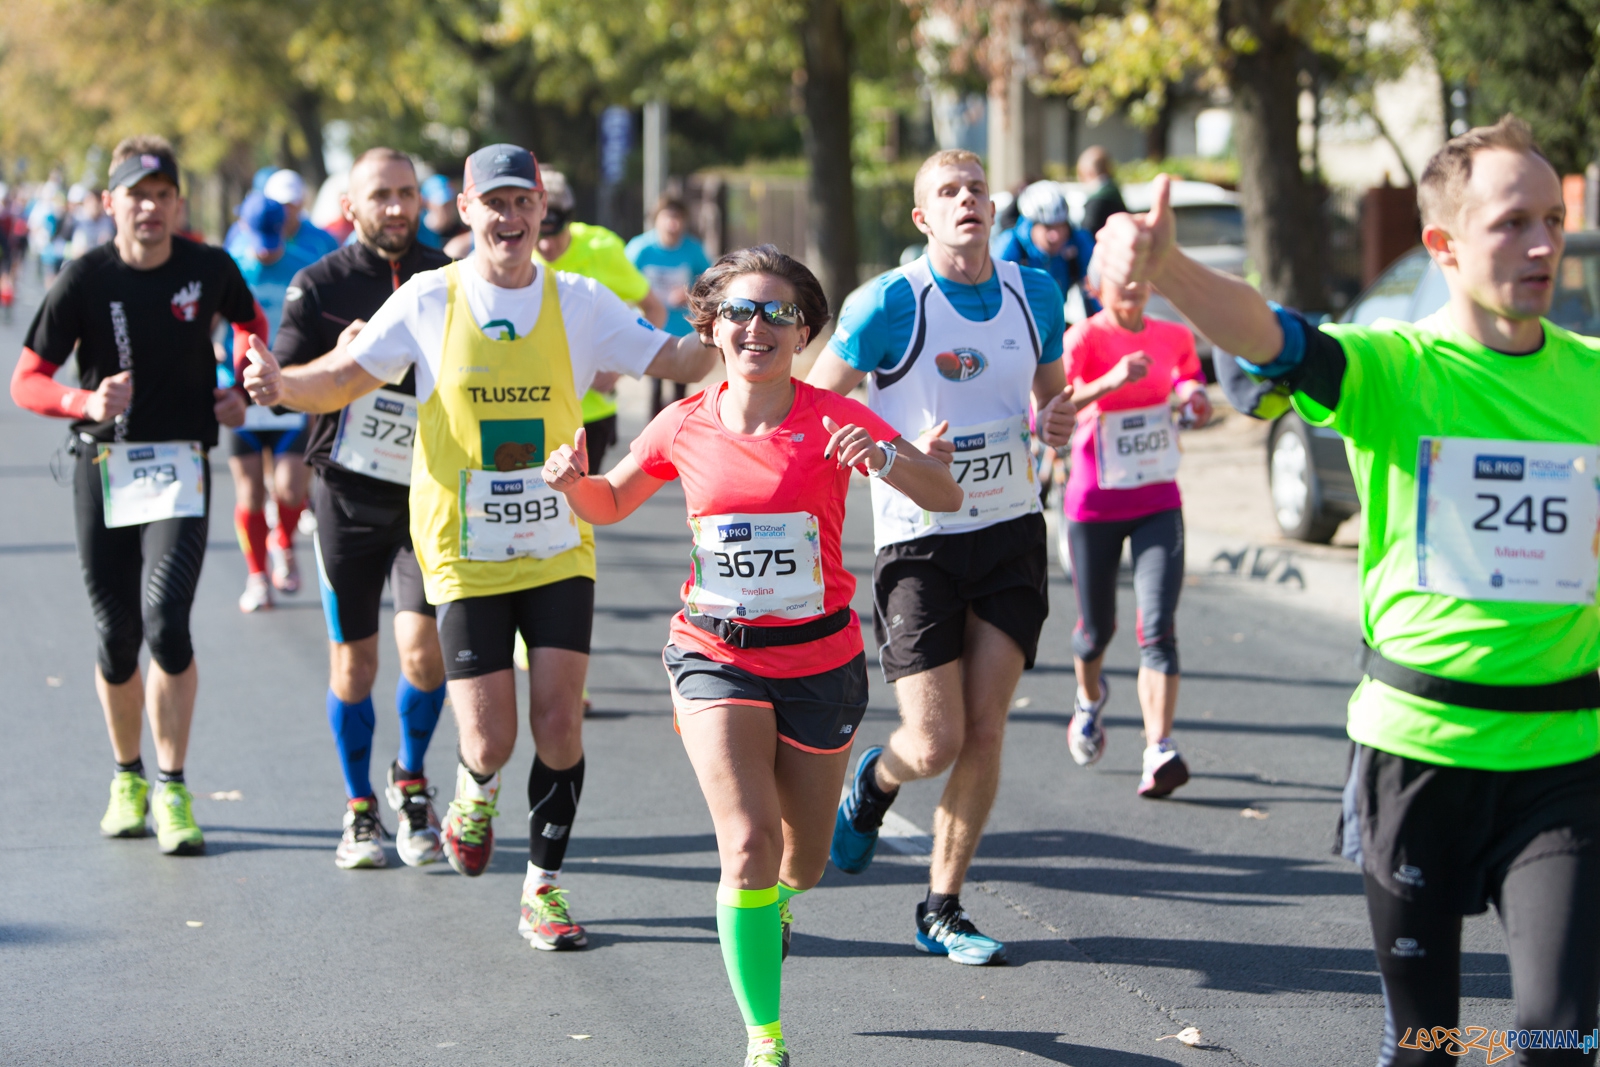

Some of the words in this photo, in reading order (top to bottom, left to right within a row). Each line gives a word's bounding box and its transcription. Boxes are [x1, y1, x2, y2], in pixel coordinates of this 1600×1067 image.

[468, 386, 551, 403] TŁUSZCZ
[361, 414, 416, 448] 372
[953, 452, 1013, 484] 7371
[484, 496, 559, 524] 5993
[1473, 494, 1568, 534] 246
[714, 549, 797, 578] 3675
[741, 587, 774, 596] Ewelina
